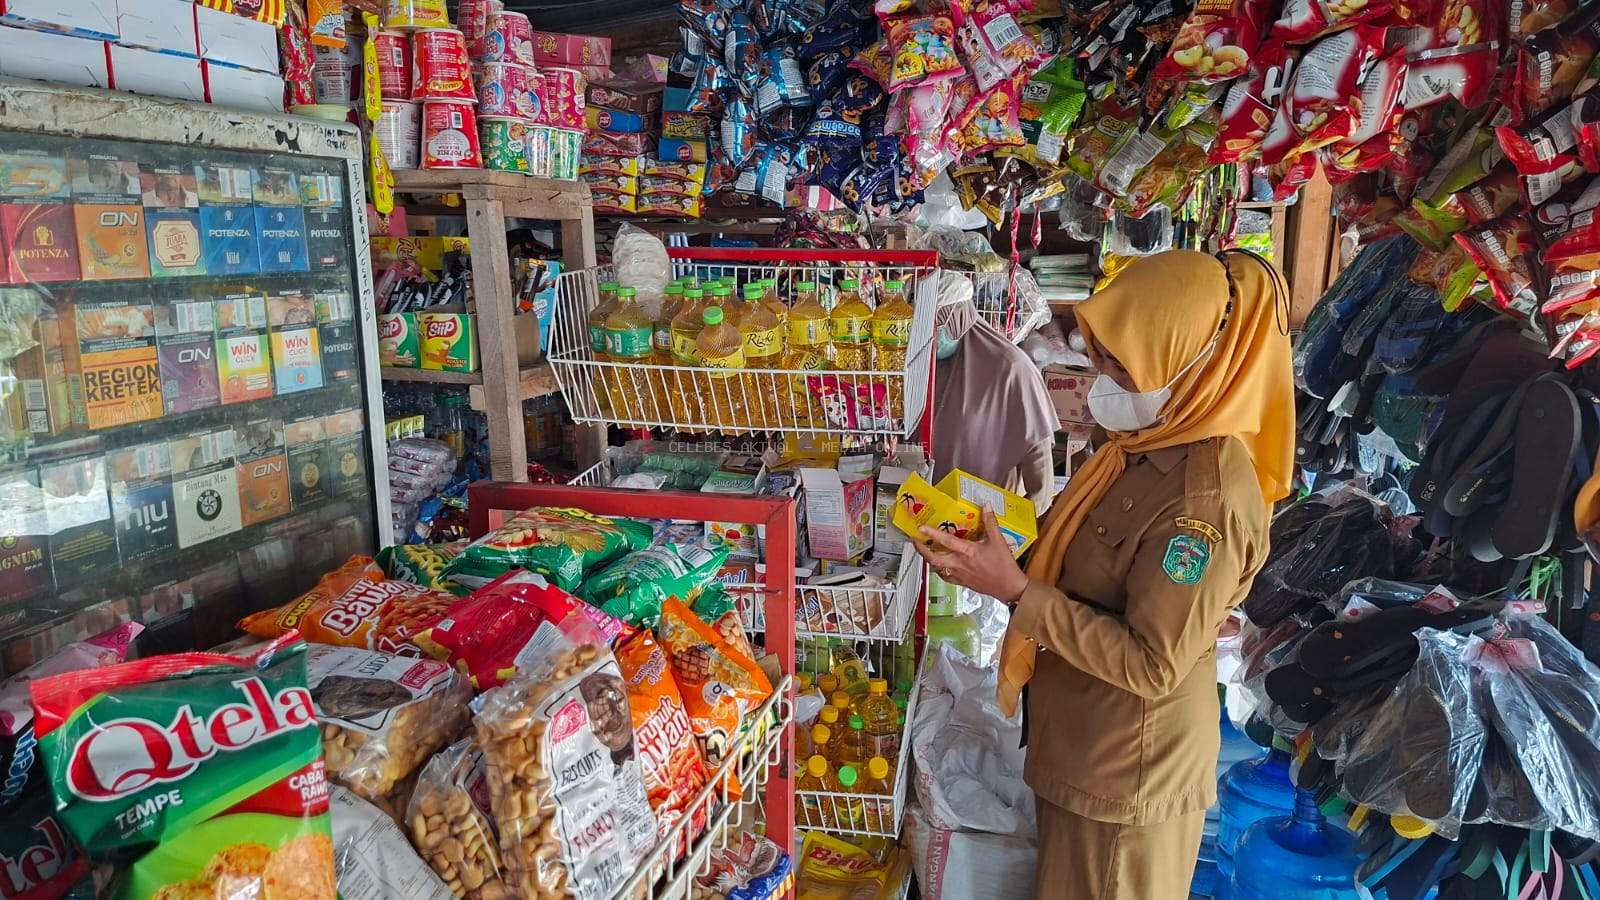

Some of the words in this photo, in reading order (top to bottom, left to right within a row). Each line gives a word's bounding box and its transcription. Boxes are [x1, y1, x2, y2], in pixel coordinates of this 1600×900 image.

[101, 210, 139, 227] ON
[209, 229, 251, 238] POTENZA
[263, 229, 300, 238] POTENZA
[311, 229, 341, 239] POTENZA
[20, 248, 69, 259] POTENZA
[231, 342, 258, 356] WIN
[285, 336, 309, 350] WIN
[324, 343, 353, 354] POTENZA
[178, 348, 211, 363] ON
[84, 363, 160, 388] REGION
[87, 380, 161, 403] KRETEK
[253, 460, 282, 478] ON
[638, 697, 675, 746] rupuk
[67, 677, 318, 803] Qtela
[289, 770, 325, 790] CABAI
[115, 789, 184, 830] TEMPE
